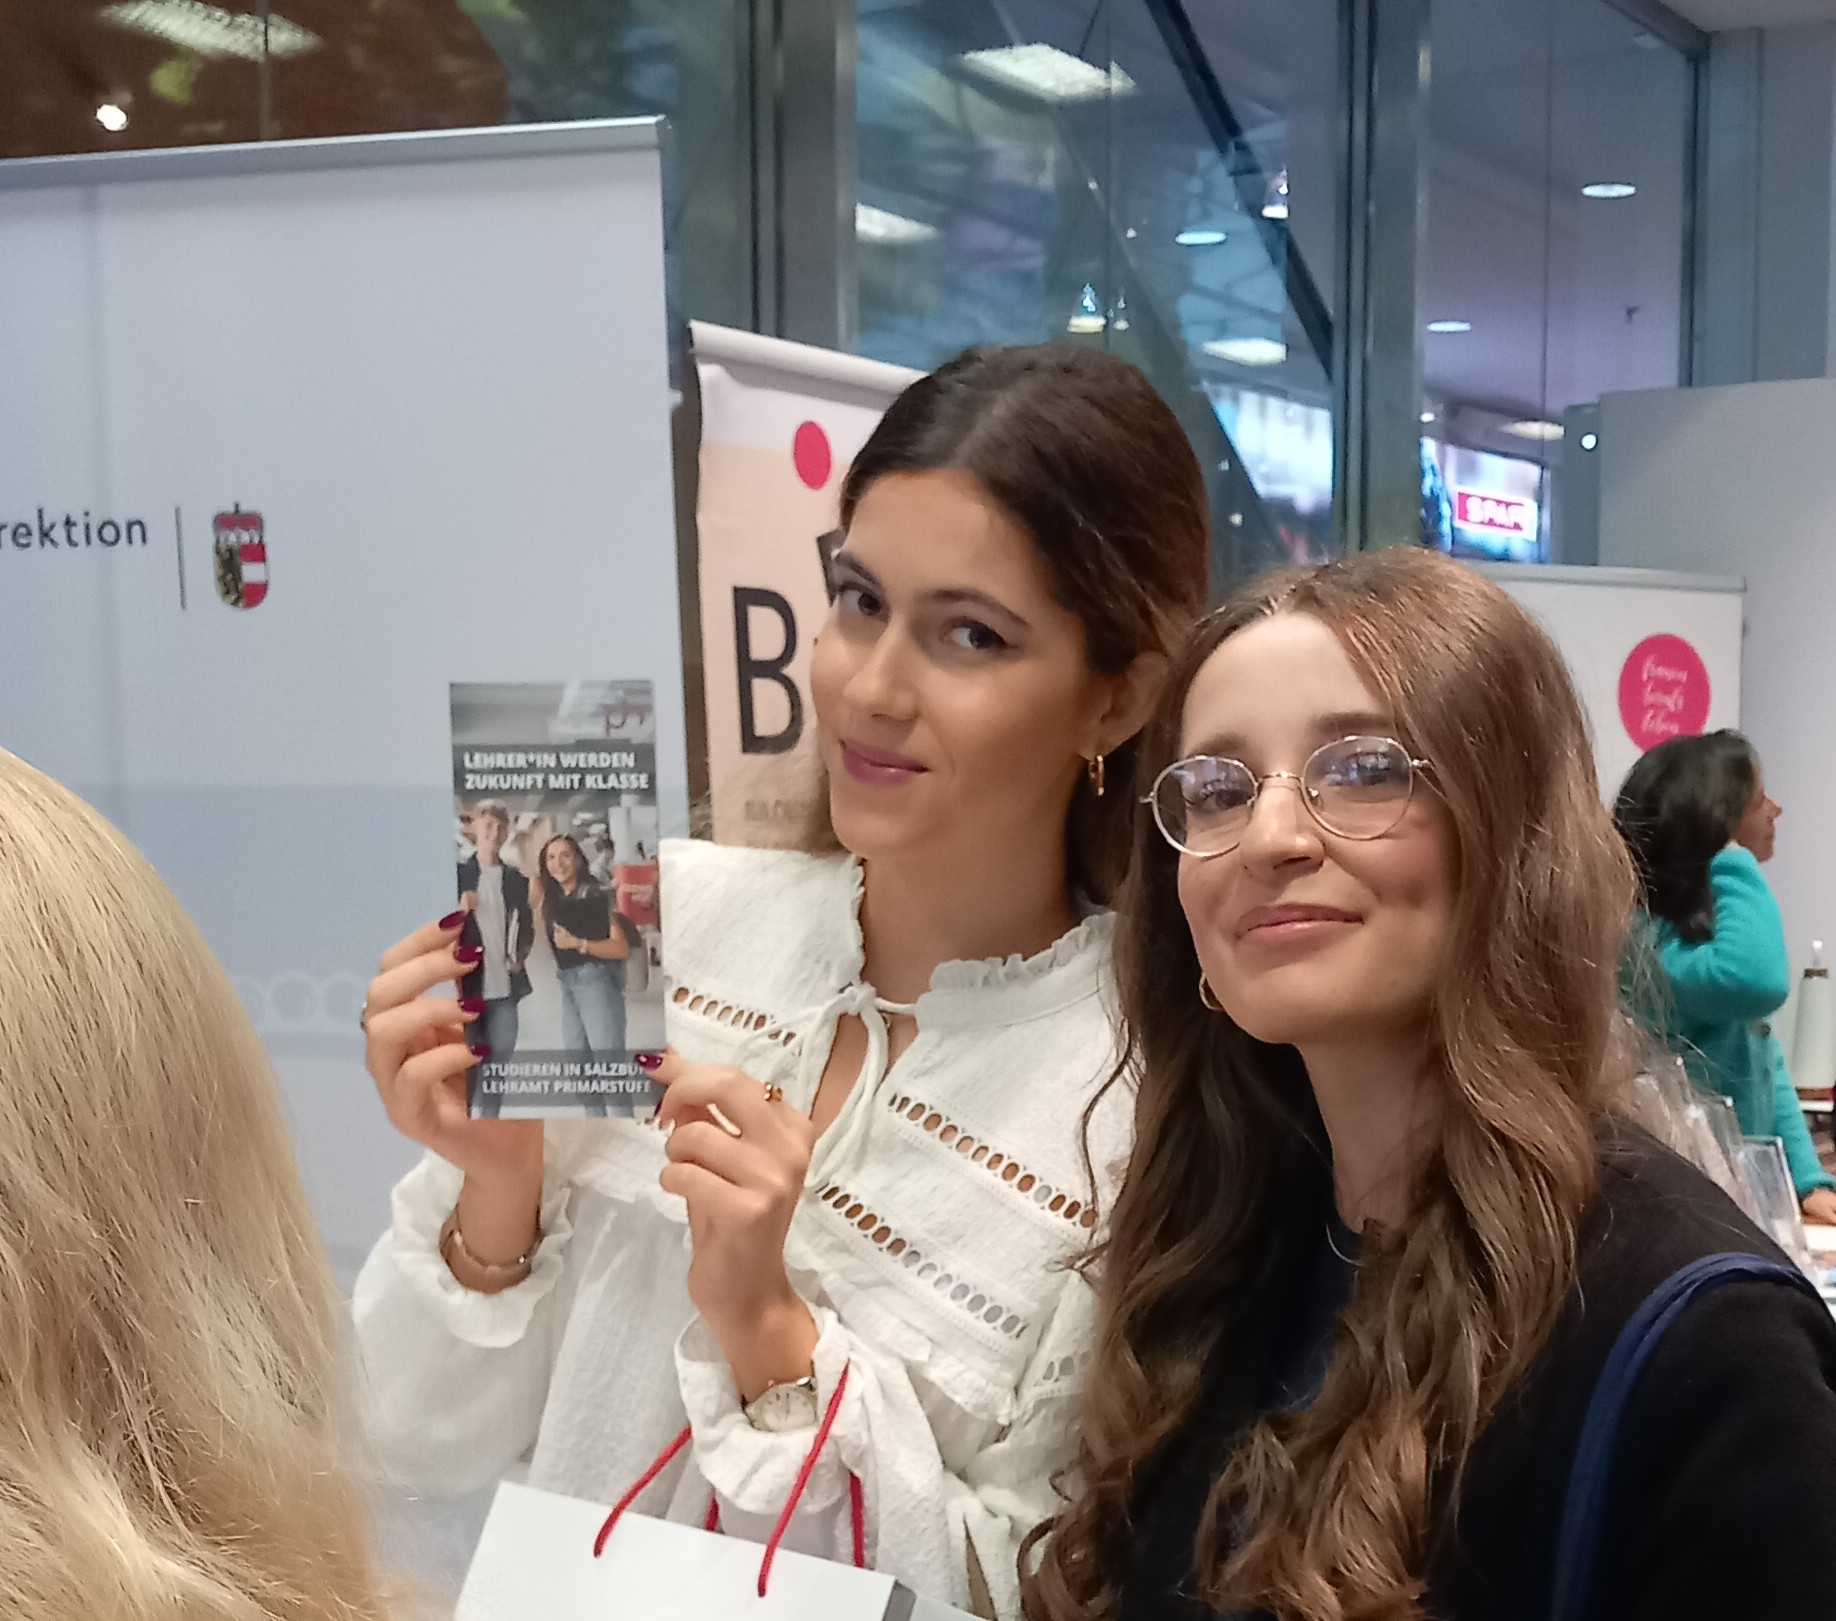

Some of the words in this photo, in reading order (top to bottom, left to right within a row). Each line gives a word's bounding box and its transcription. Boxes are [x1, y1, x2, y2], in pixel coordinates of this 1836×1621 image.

[560, 752, 635, 768] WERDEN
[464, 773, 545, 790] ZUKUNFT
[549, 773, 582, 789] MIT
[585, 773, 649, 789] KLASSE
[483, 1063, 561, 1076] STUDIEREN
[564, 1063, 580, 1076] IN
[584, 1063, 645, 1076] SALZBU
[482, 1080, 550, 1093] LEHRAMT
